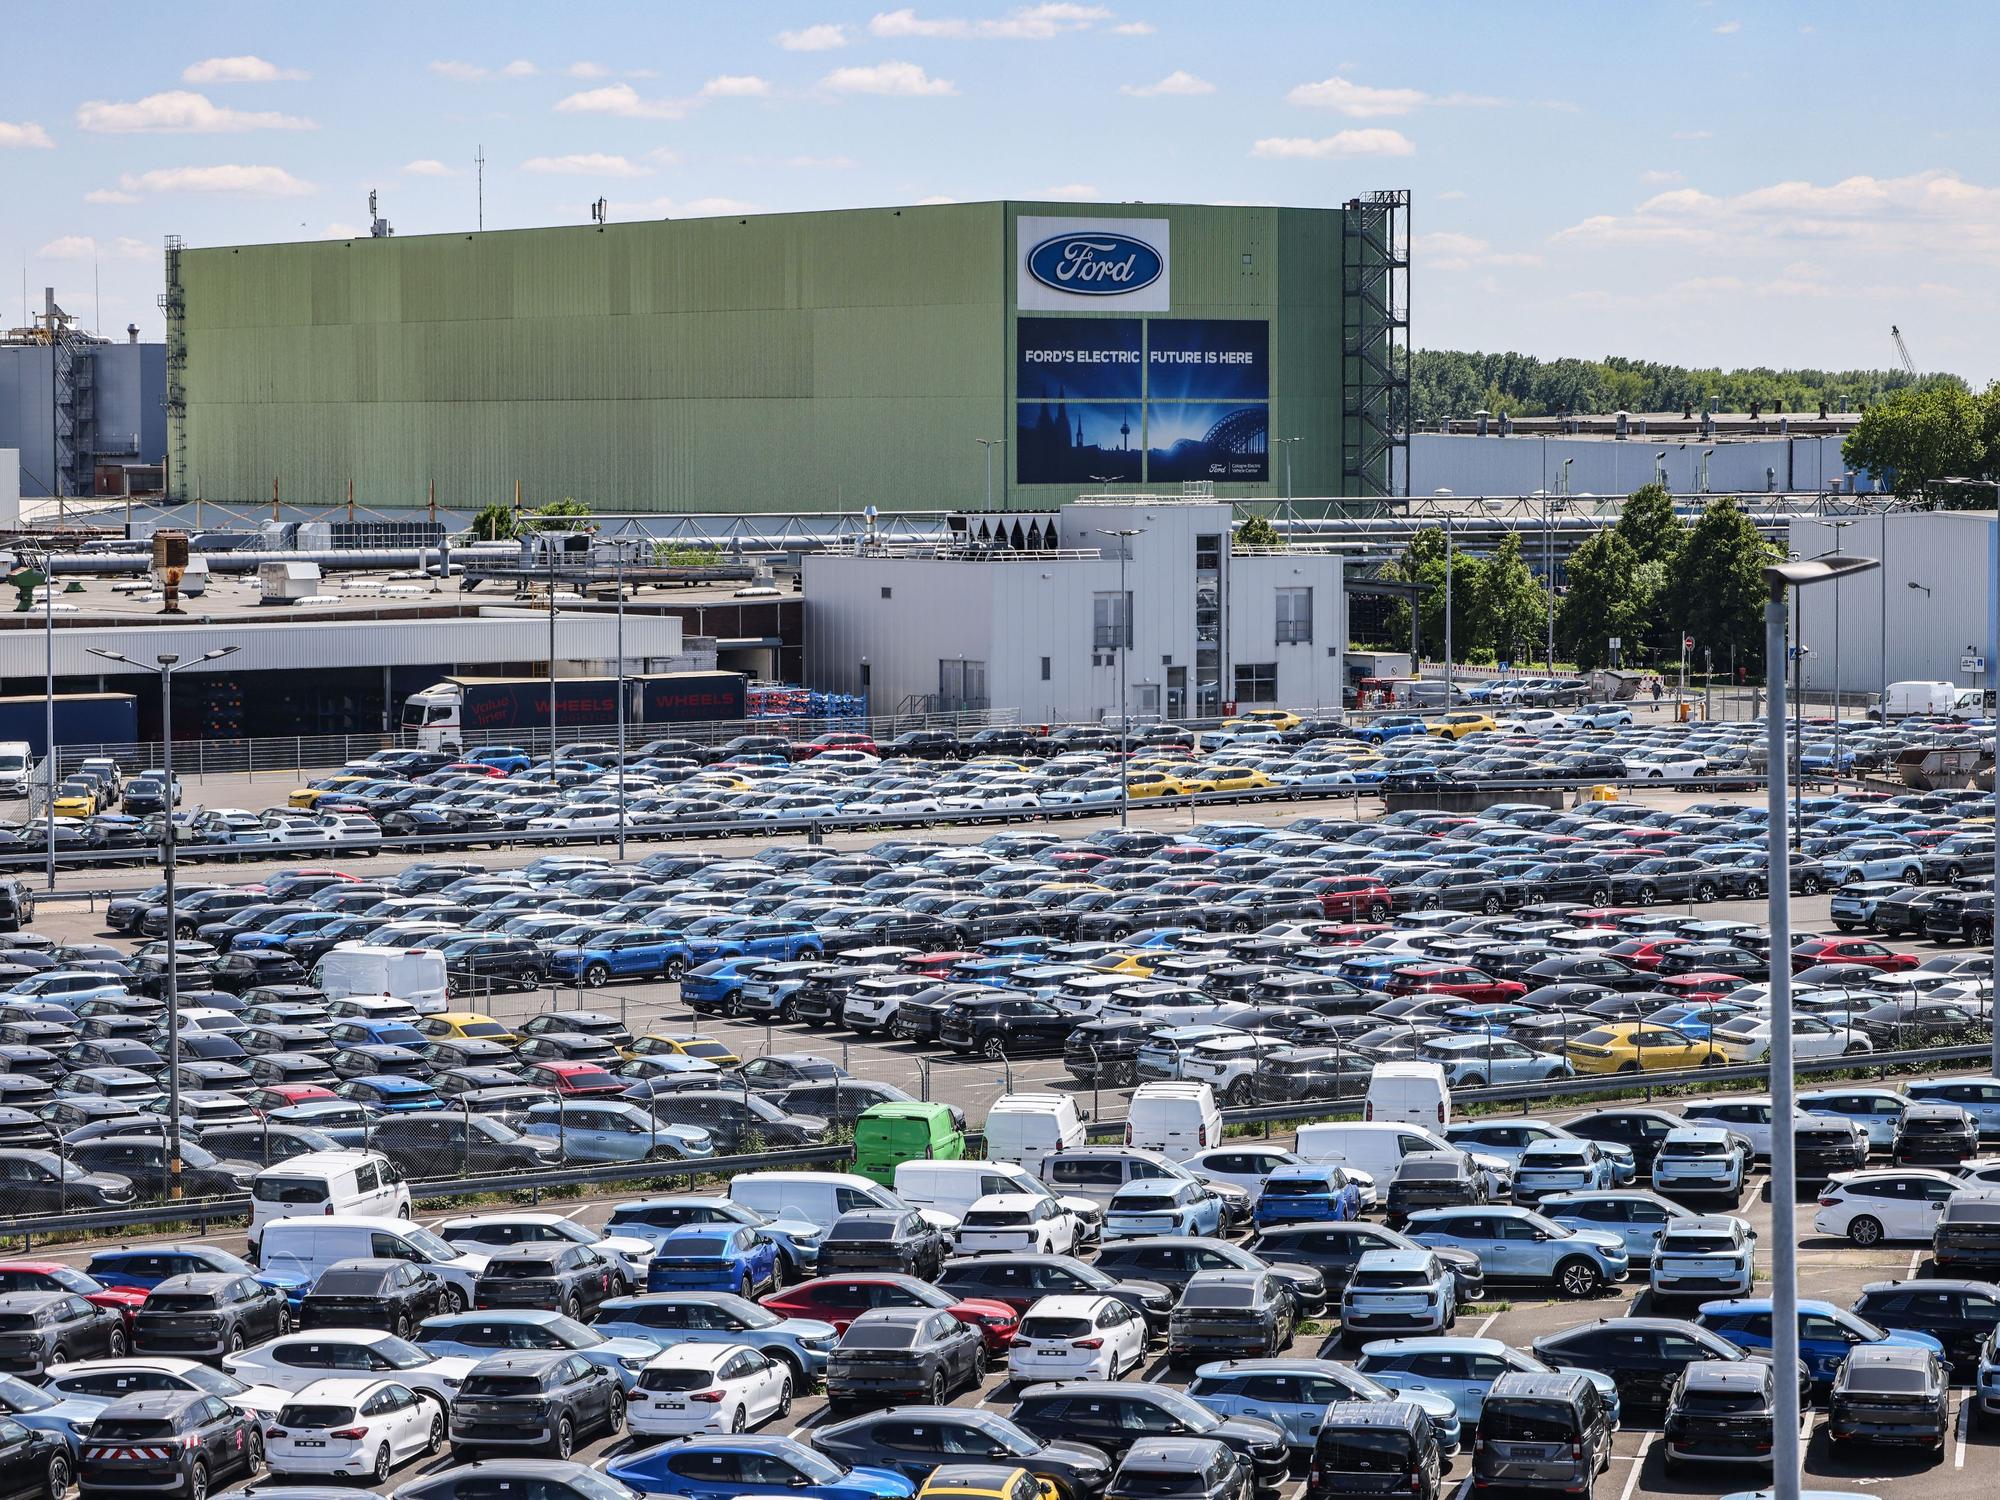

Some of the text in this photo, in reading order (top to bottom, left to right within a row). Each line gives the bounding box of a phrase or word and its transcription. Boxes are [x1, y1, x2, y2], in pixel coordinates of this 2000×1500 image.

[1056, 241, 1137, 282] Ford
[1025, 350, 1253, 365] FORD'S ELECTRIC FUTURE IS HERE
[1208, 463, 1227, 473] Ford
[471, 697, 511, 715] Value
[534, 697, 615, 713] WHEELS
[655, 692, 734, 708] WHEELS
